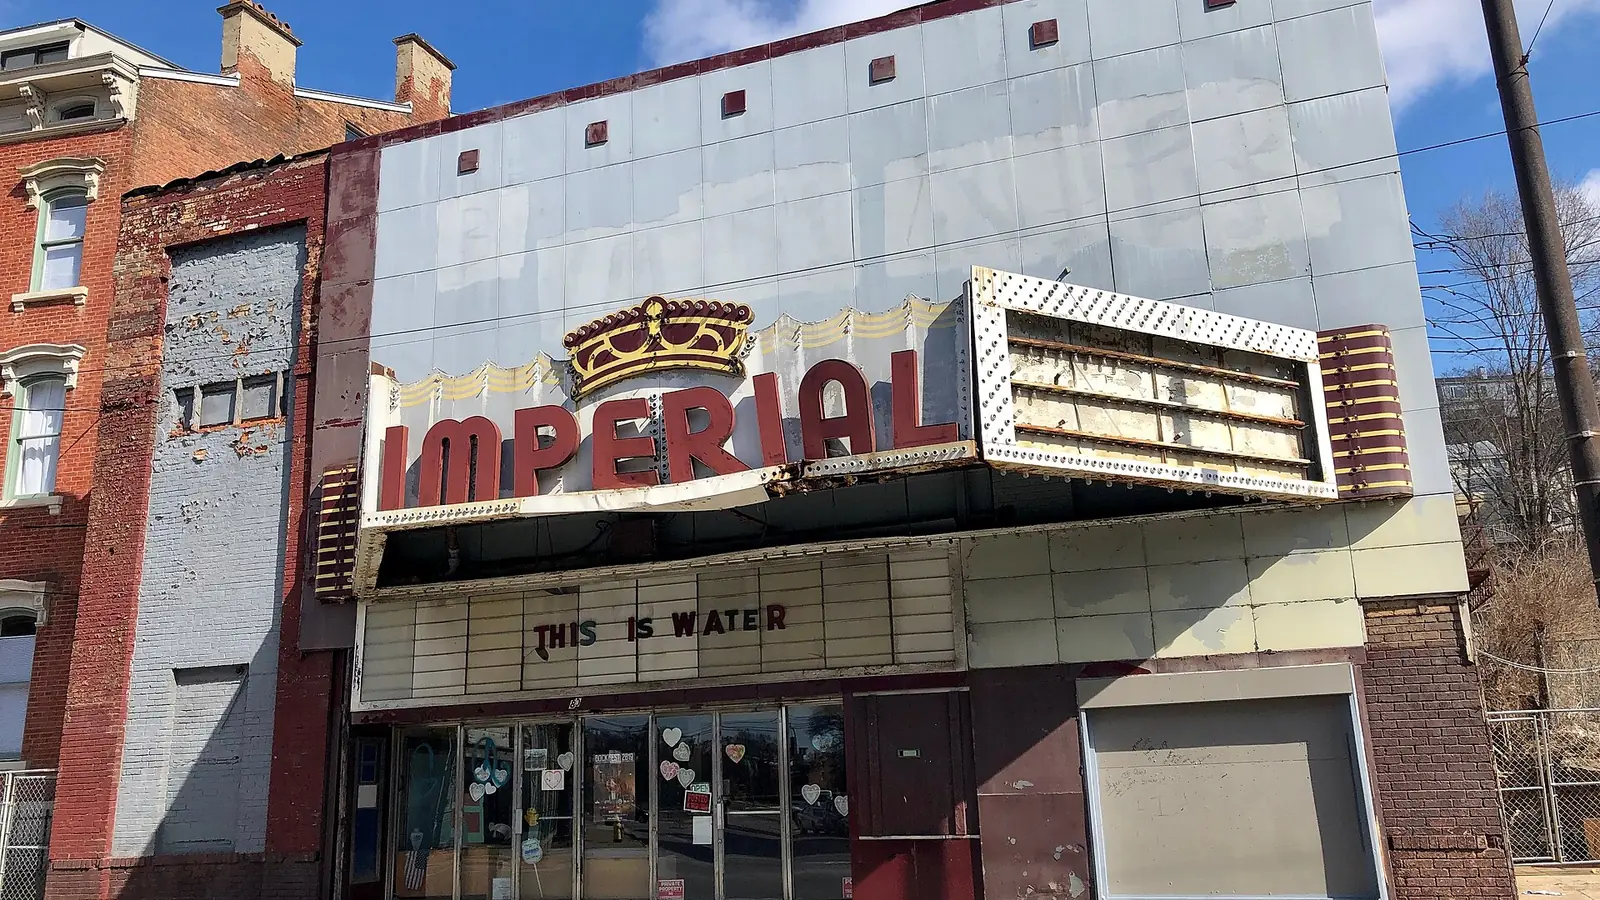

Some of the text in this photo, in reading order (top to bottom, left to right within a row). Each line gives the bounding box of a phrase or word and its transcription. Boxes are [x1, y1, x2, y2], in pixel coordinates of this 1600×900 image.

[381, 349, 959, 511] IMPERIAL
[533, 604, 786, 650] THIS IS WATER
[691, 784, 709, 792] OPEN
